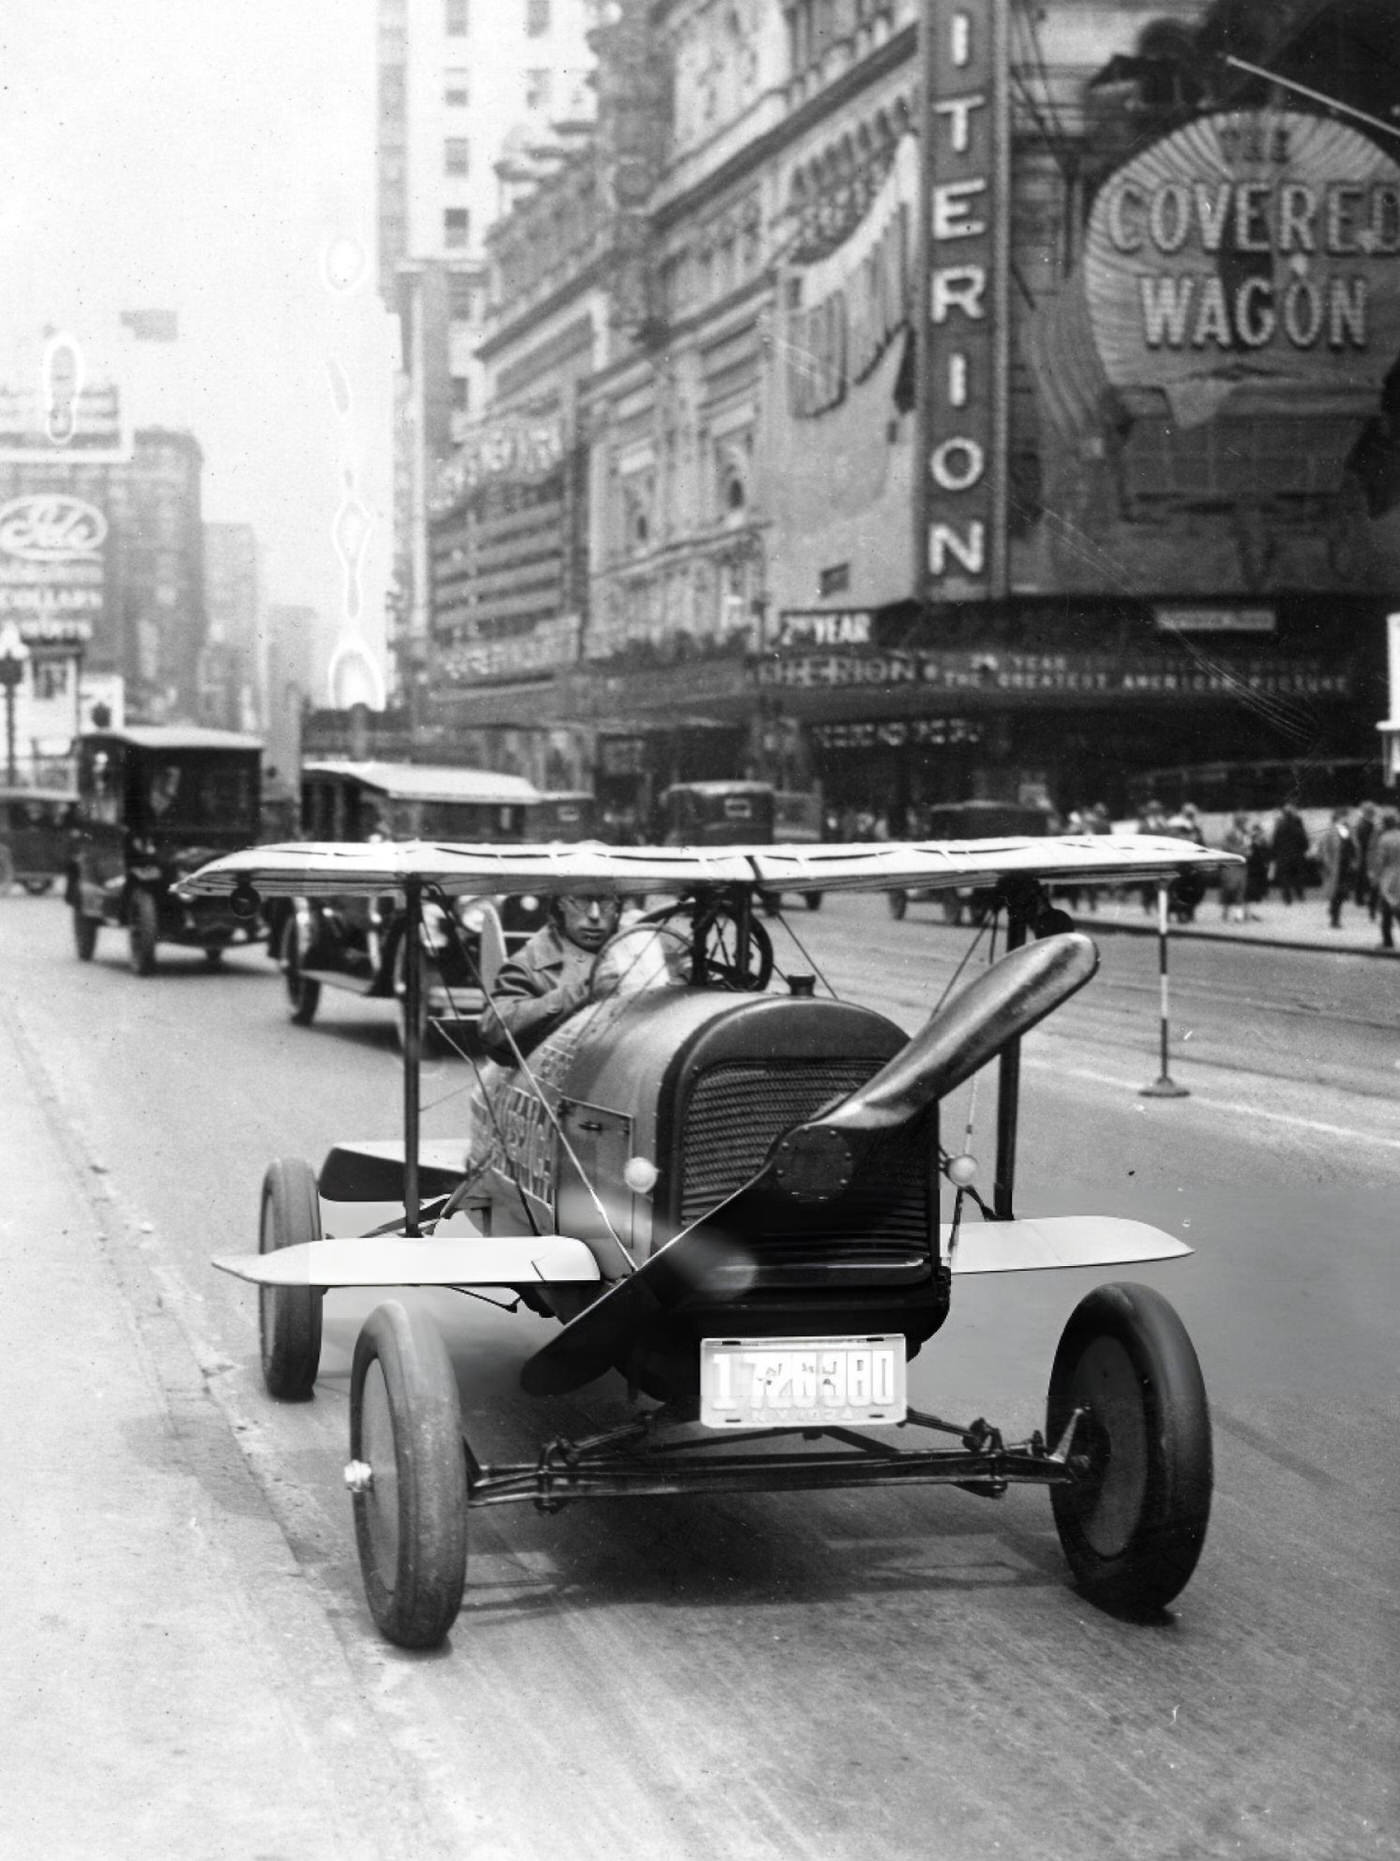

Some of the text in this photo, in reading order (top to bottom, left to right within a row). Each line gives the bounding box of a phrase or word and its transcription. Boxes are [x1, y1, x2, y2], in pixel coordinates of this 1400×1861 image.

[1107, 181, 1400, 256] COVERED
[928, 15, 986, 575] ITERION
[1138, 276, 1369, 351] WAGON
[814, 612, 871, 645] YEAR
[944, 671, 980, 689] THE
